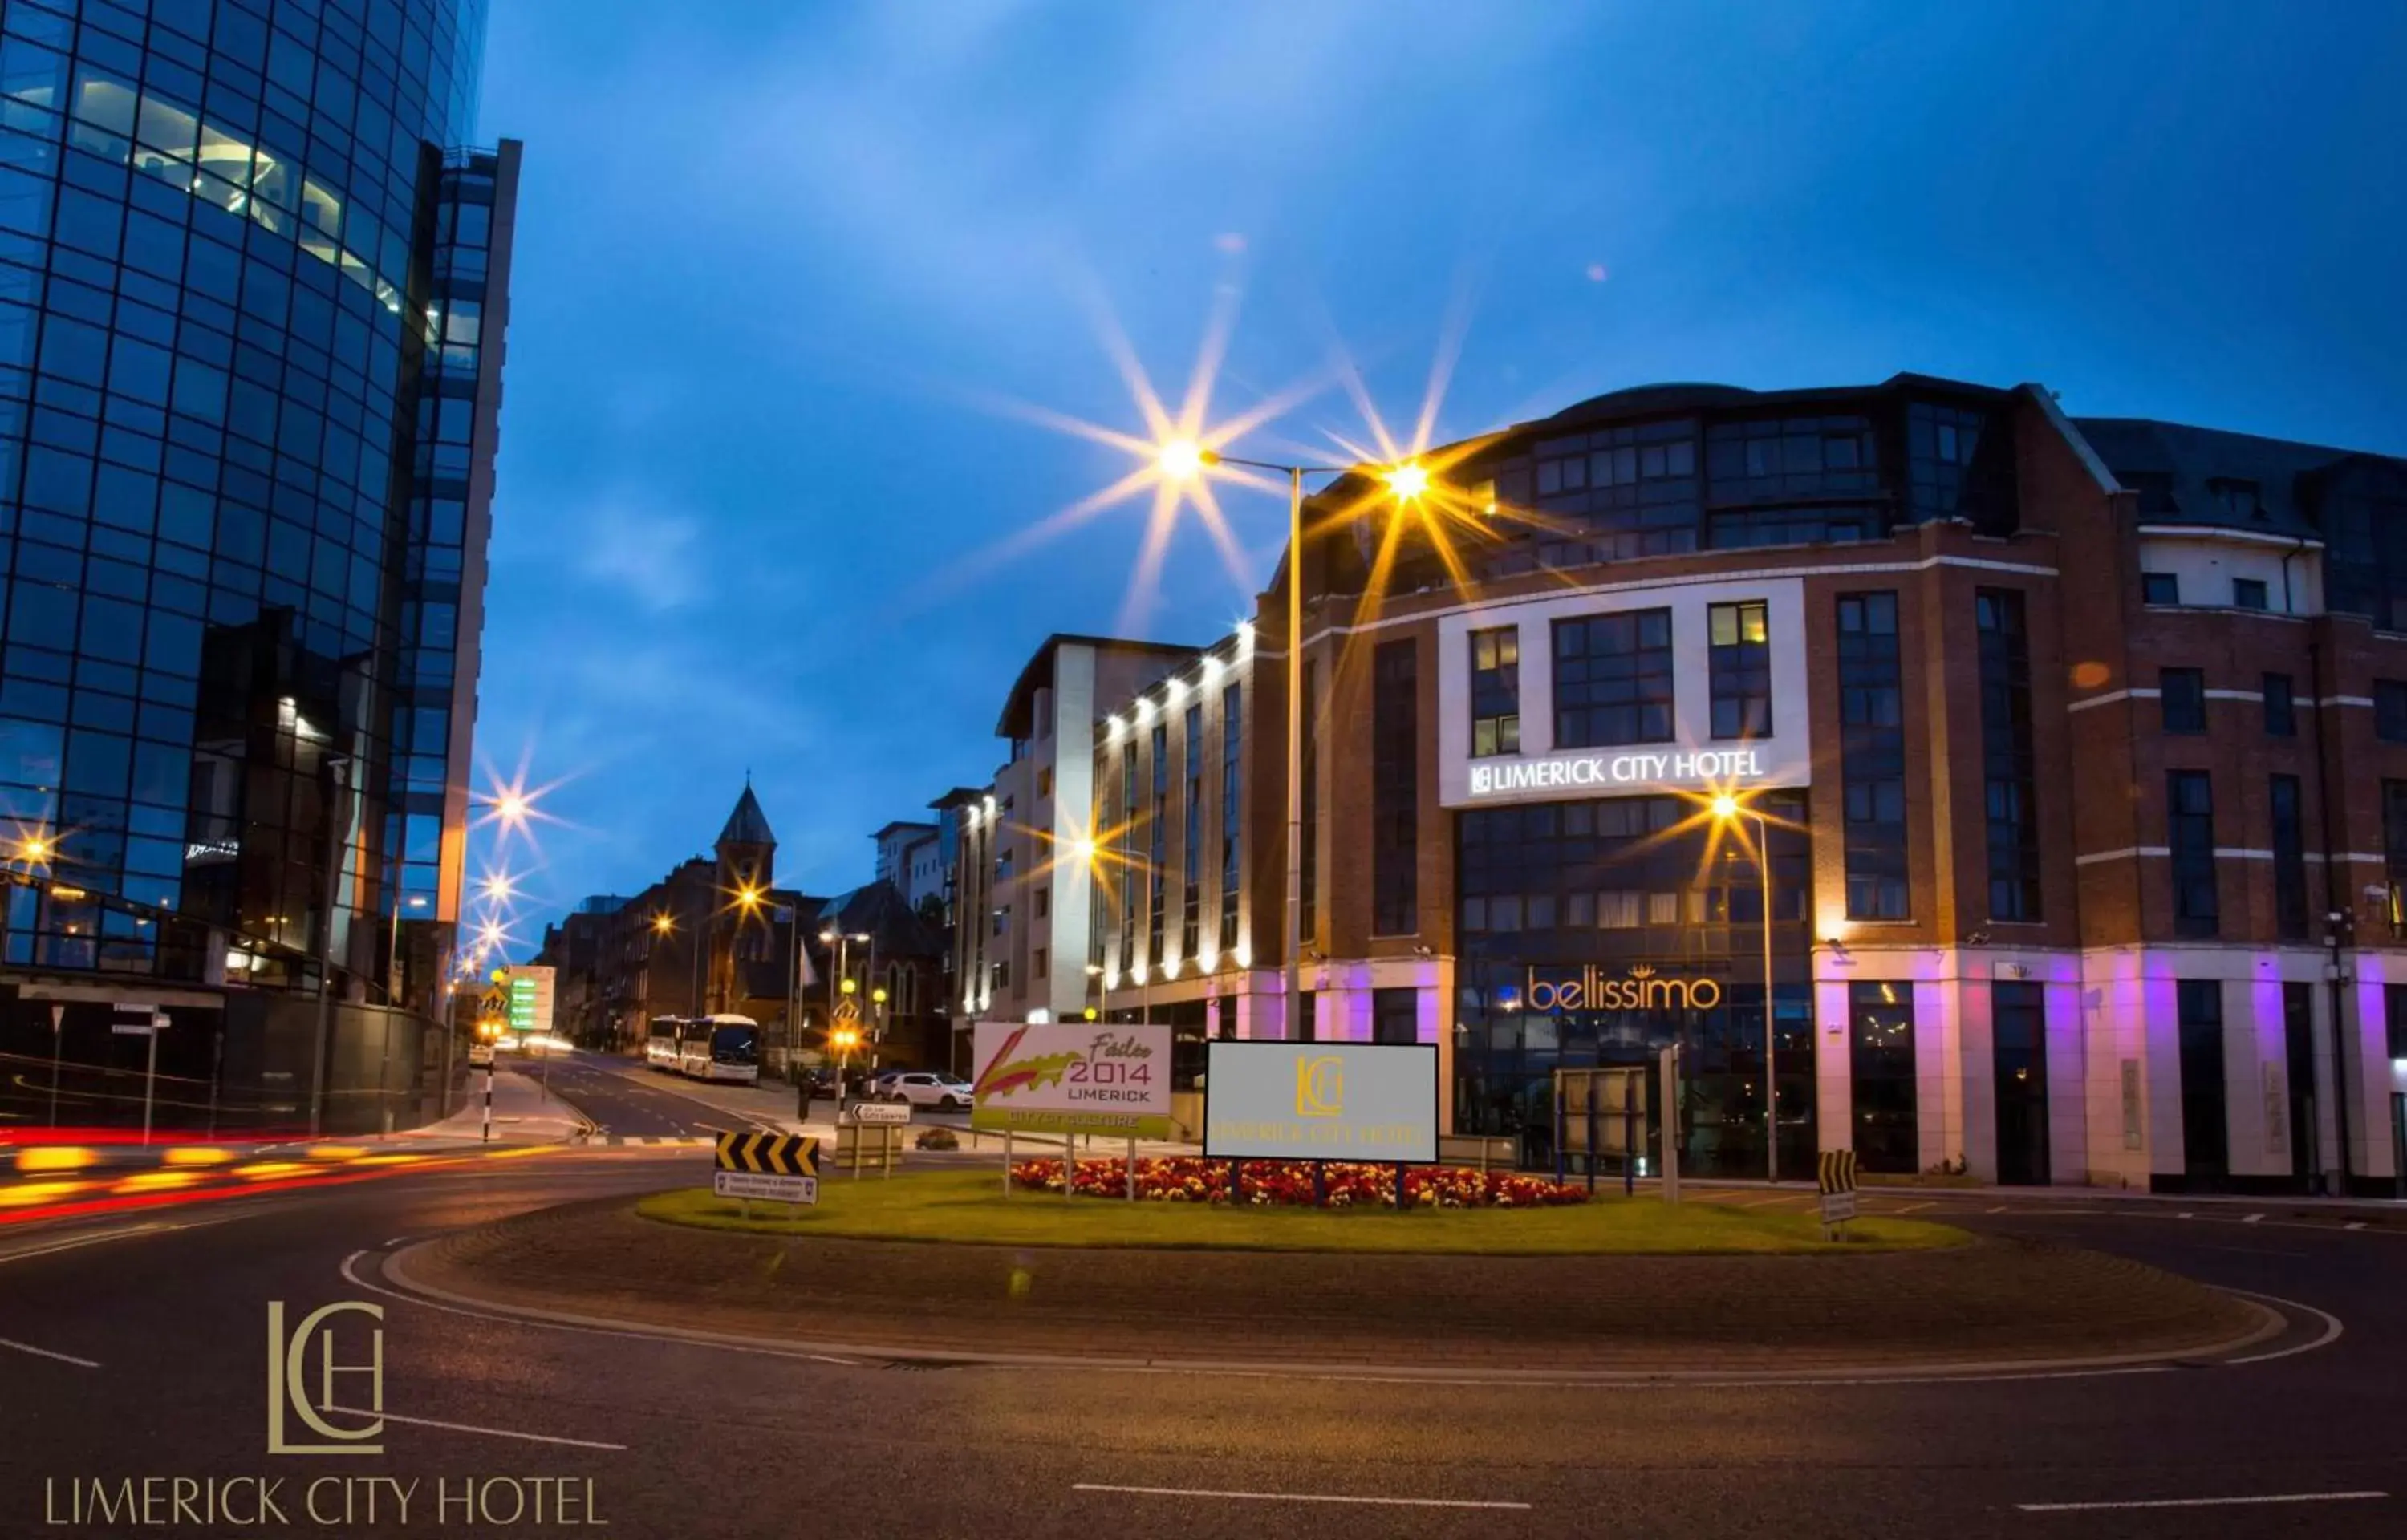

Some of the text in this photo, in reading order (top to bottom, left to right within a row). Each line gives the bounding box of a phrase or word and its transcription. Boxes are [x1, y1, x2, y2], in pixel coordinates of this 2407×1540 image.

[1493, 758, 1605, 790] LIMERICK
[1611, 754, 1668, 781] CITY
[1675, 751, 1764, 779] HOTEL
[1528, 963, 1720, 1011] bellissimo
[1069, 1061, 1151, 1085] 2014
[1068, 1088, 1151, 1103] LIMERICK
[1009, 1110, 1044, 1125] CITY
[1068, 1113, 1140, 1129] CULTURE
